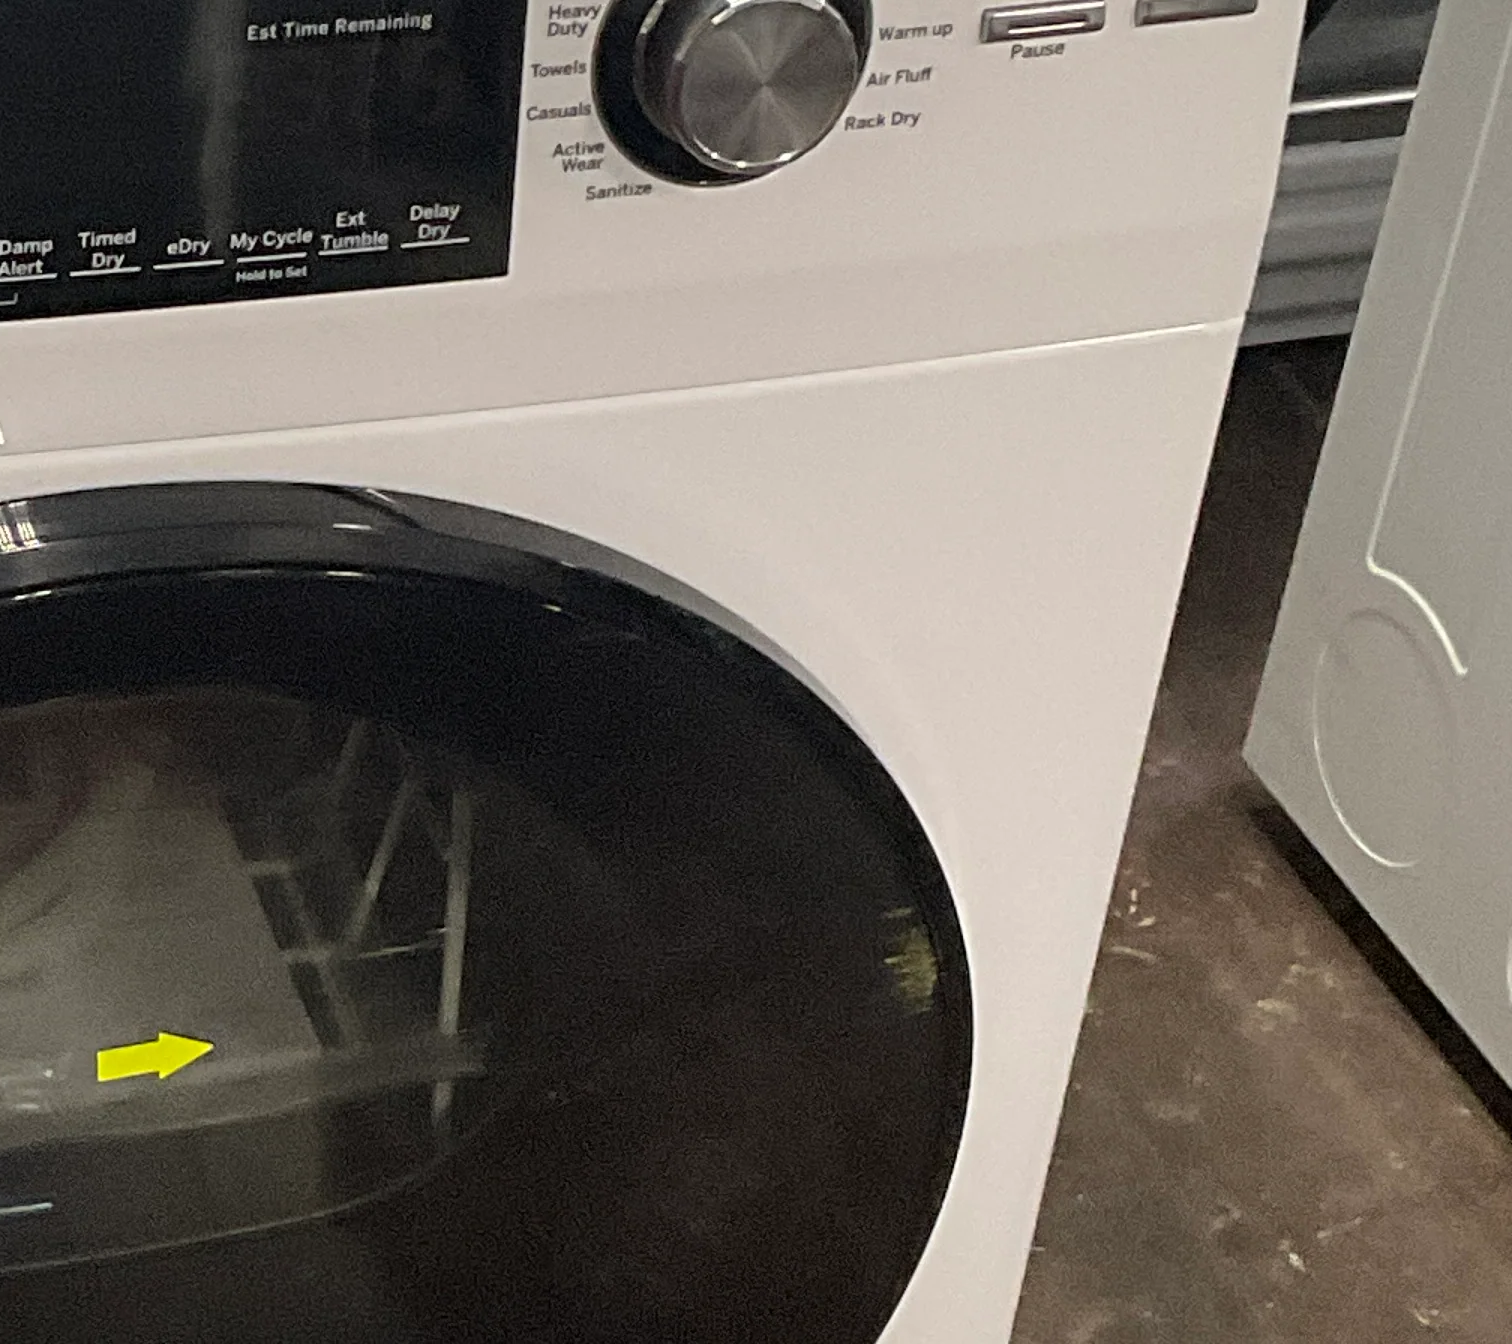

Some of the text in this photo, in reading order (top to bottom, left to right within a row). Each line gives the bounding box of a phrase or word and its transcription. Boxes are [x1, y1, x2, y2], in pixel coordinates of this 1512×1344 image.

[548, 2, 602, 20] Heavy
[246, 11, 433, 42] Est Time Remaining
[547, 20, 588, 38] Duty
[878, 22, 954, 41] Warm up
[1010, 41, 1066, 60] Pause
[531, 60, 587, 79] Towels
[866, 66, 934, 88] Air Fluff
[526, 102, 592, 122] Casuals
[844, 110, 922, 131] Rack Dry
[552, 139, 606, 158] Active
[562, 156, 603, 173] Wear
[585, 180, 653, 201] Sanitize
[335, 211, 367, 229] Ext
[409, 203, 461, 222] Delay
[78, 228, 137, 249] Timed
[230, 227, 313, 251] My Cycle
[418, 222, 451, 240] Dry
[167, 238, 212, 256] eDry
[320, 231, 389, 251] Tumble
[91, 251, 126, 269] Dry
